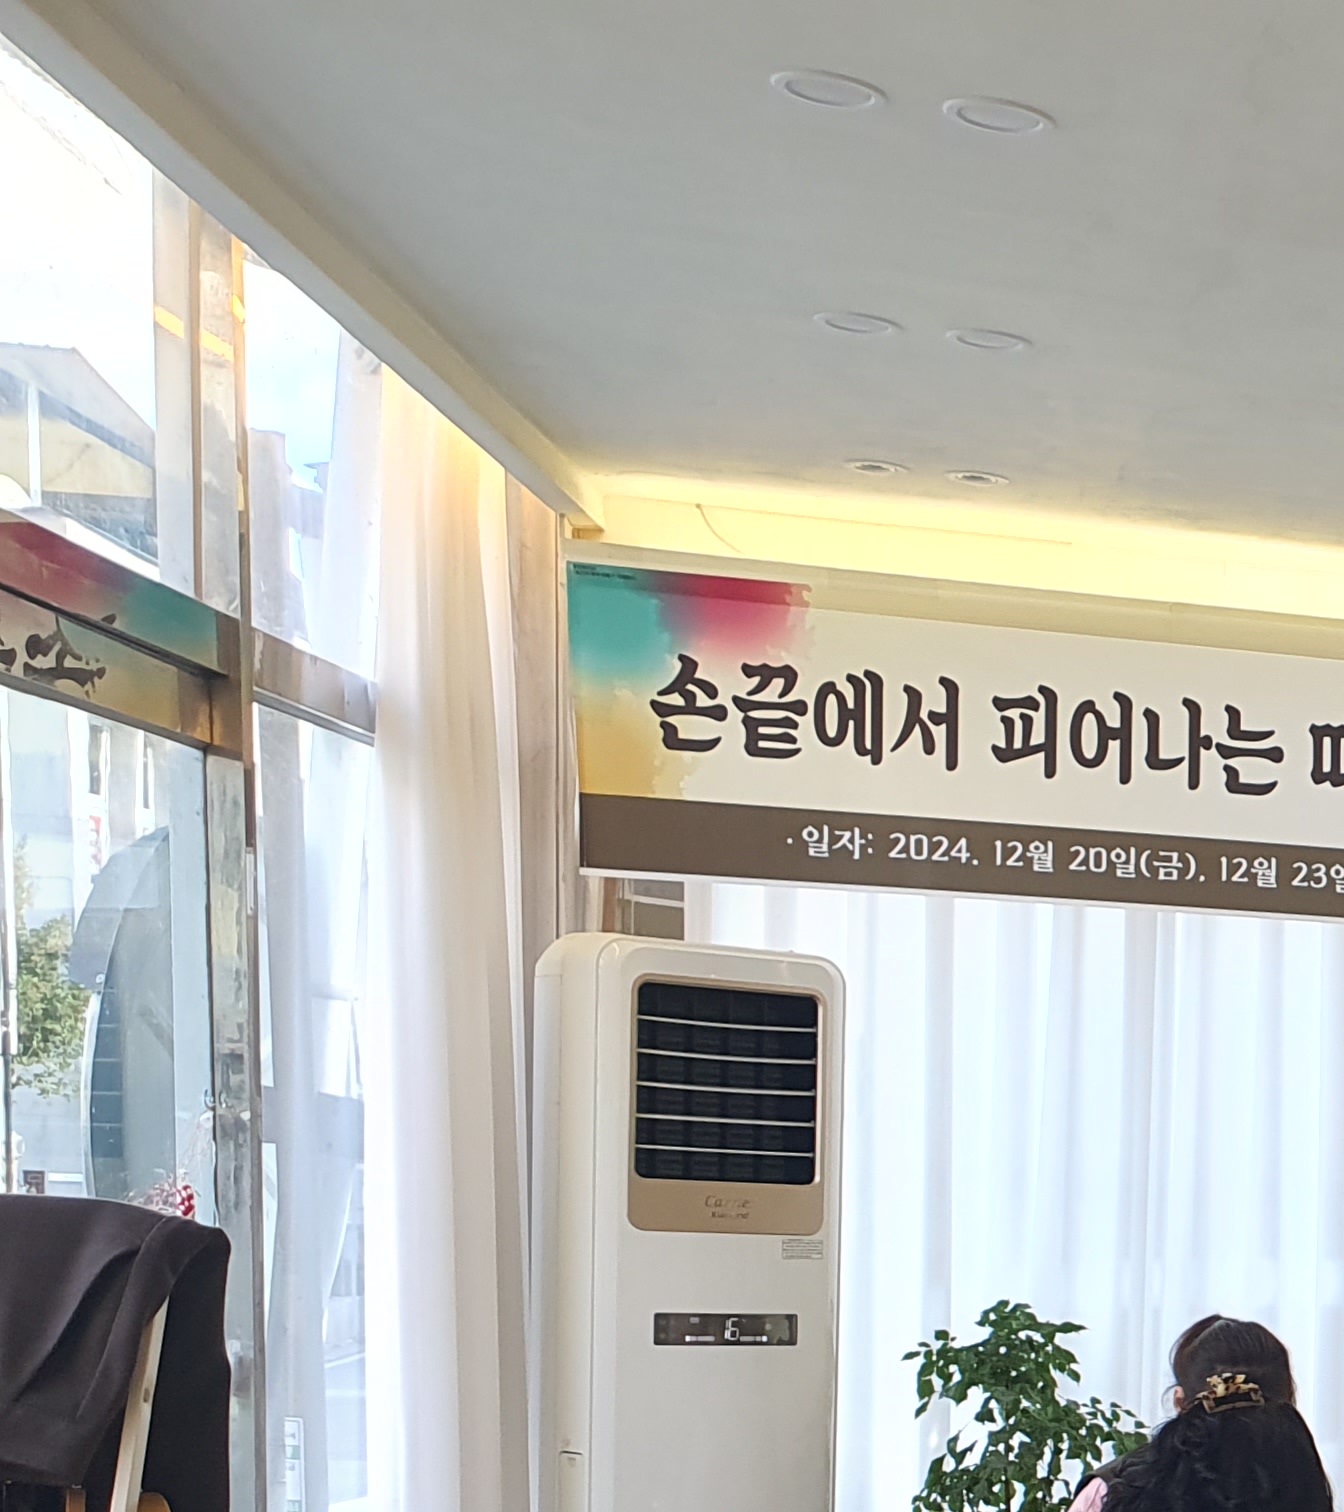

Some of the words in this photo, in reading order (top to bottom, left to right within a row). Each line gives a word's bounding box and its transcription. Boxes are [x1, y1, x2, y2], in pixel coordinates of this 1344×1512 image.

[648, 652, 961, 773] 손끝에서
[990, 683, 1286, 797] 피어나는
[887, 832, 980, 866] 2024.
[993, 839, 1055, 873] 12월
[1219, 855, 1278, 889] 12월
